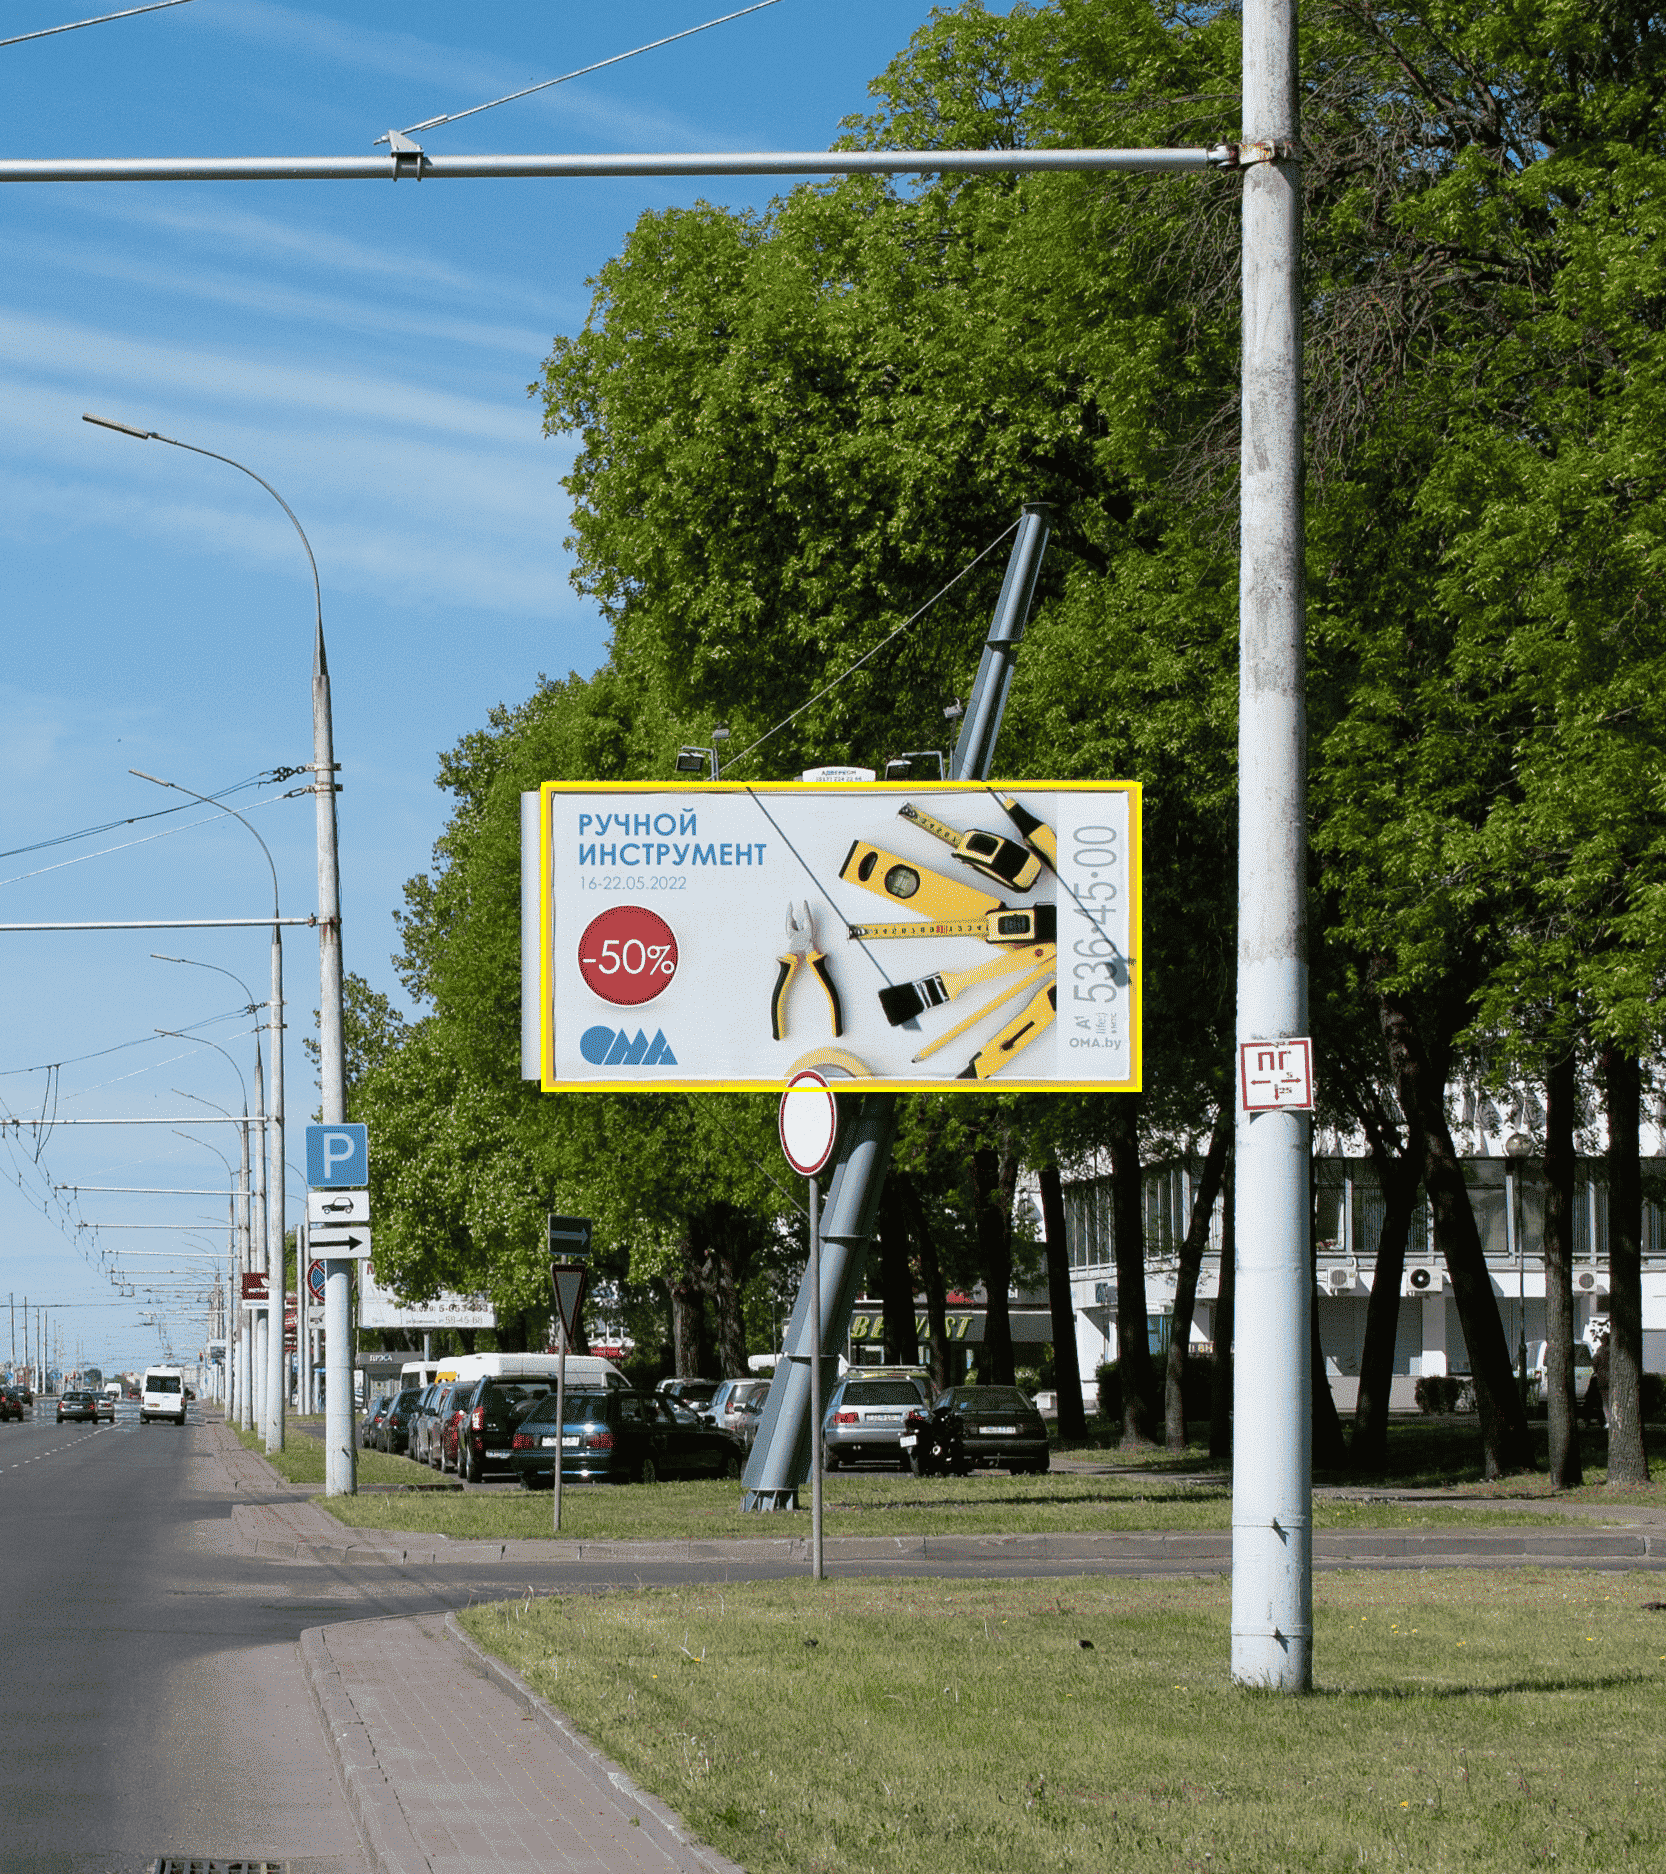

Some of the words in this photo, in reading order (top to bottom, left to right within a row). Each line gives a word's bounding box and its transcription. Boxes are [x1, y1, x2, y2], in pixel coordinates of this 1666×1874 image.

[579, 807, 697, 836] РУЧНОЙ
[579, 843, 768, 866] ИНСТРУМЕНТ
[580, 875, 687, 890] 16-22.05.2022
[582, 938, 675, 976] -50%
[1069, 1037, 1122, 1051] OMA.by
[1257, 1050, 1292, 1071] ПГ
[323, 1132, 355, 1179] P
